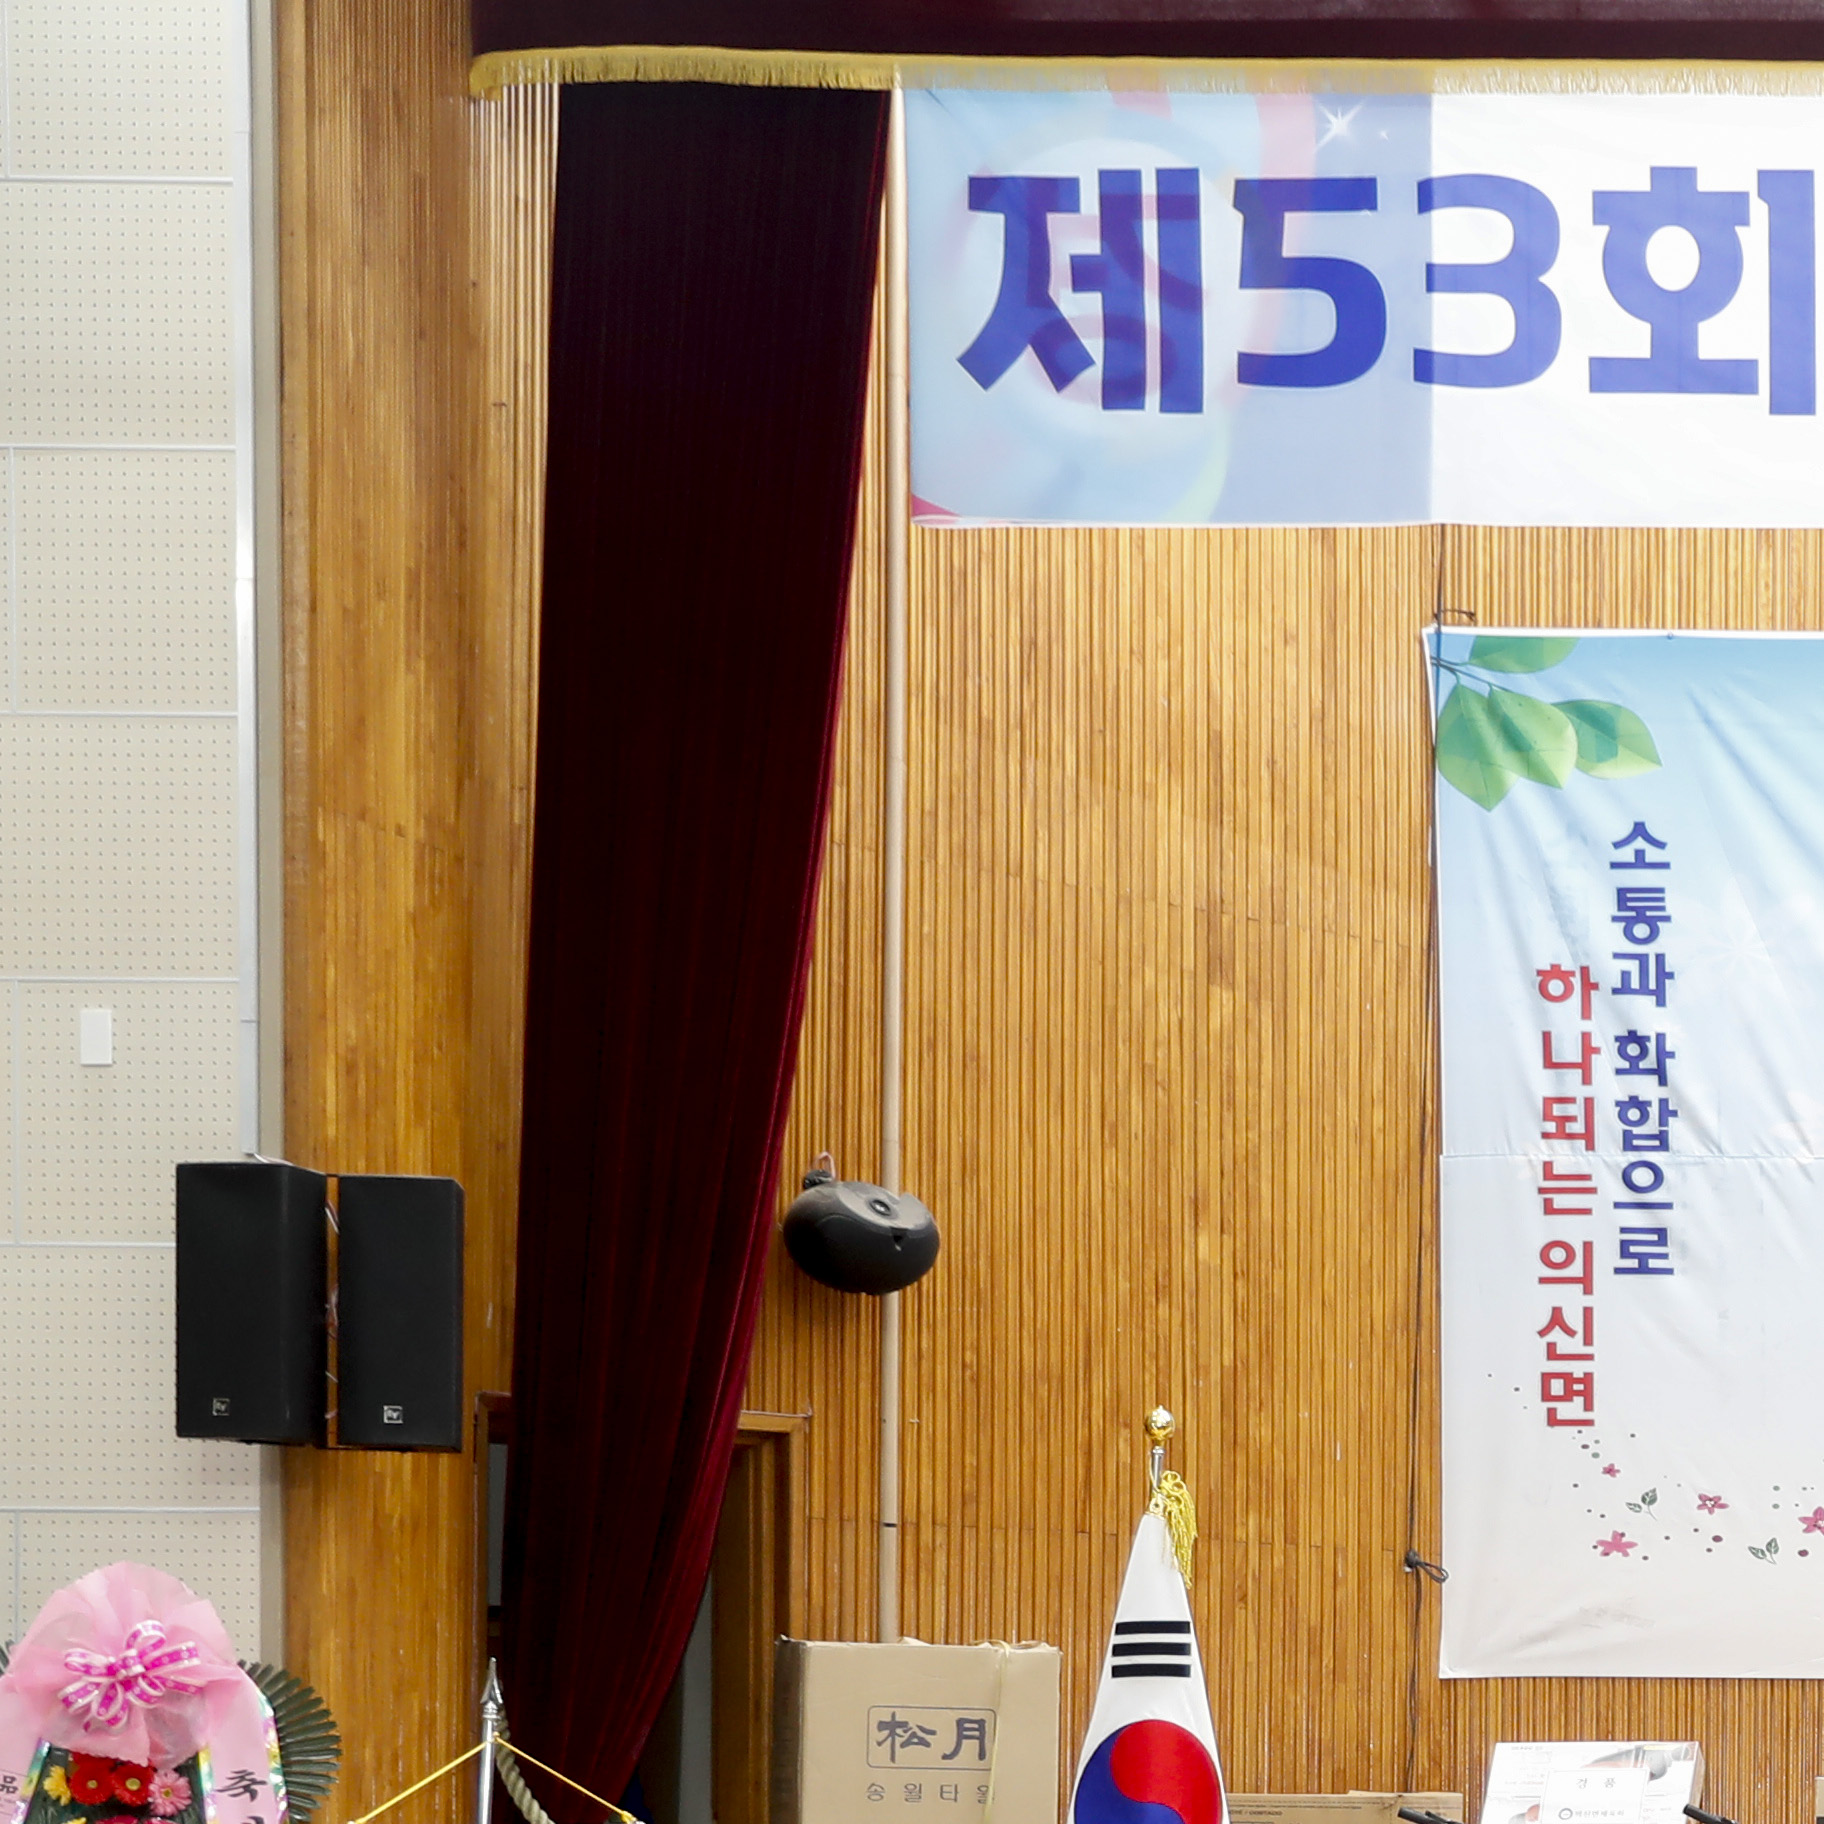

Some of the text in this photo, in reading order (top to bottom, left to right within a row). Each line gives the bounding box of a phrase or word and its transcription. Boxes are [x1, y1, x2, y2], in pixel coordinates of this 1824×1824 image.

[957, 165, 1818, 417] 제53회
[1609, 819, 1679, 1279] 소통과 화합으로
[1535, 963, 1601, 1430] 하나되는 의신면
[217, 1768, 268, 1803] 축
[875, 1710, 987, 1764] 松月
